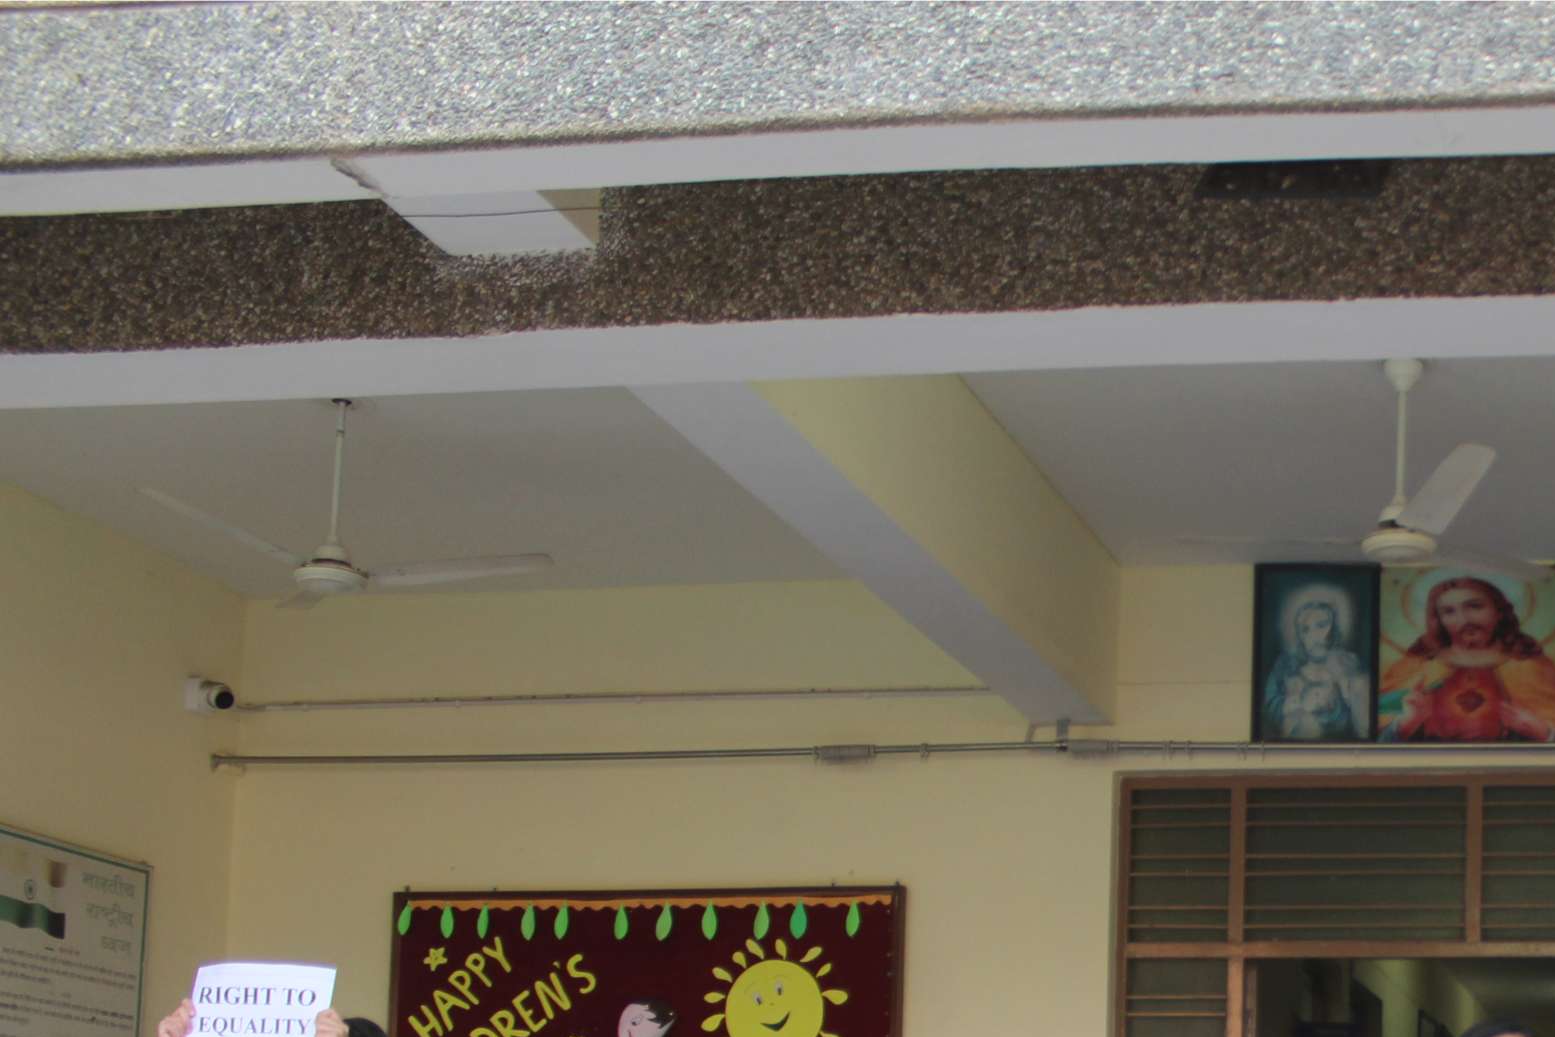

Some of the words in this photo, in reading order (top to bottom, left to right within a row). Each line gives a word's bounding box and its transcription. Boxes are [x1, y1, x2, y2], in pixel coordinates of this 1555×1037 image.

[198, 986, 277, 1006] RIGHT
[282, 987, 317, 1007] TO
[198, 1016, 312, 1037] EQUALITY
